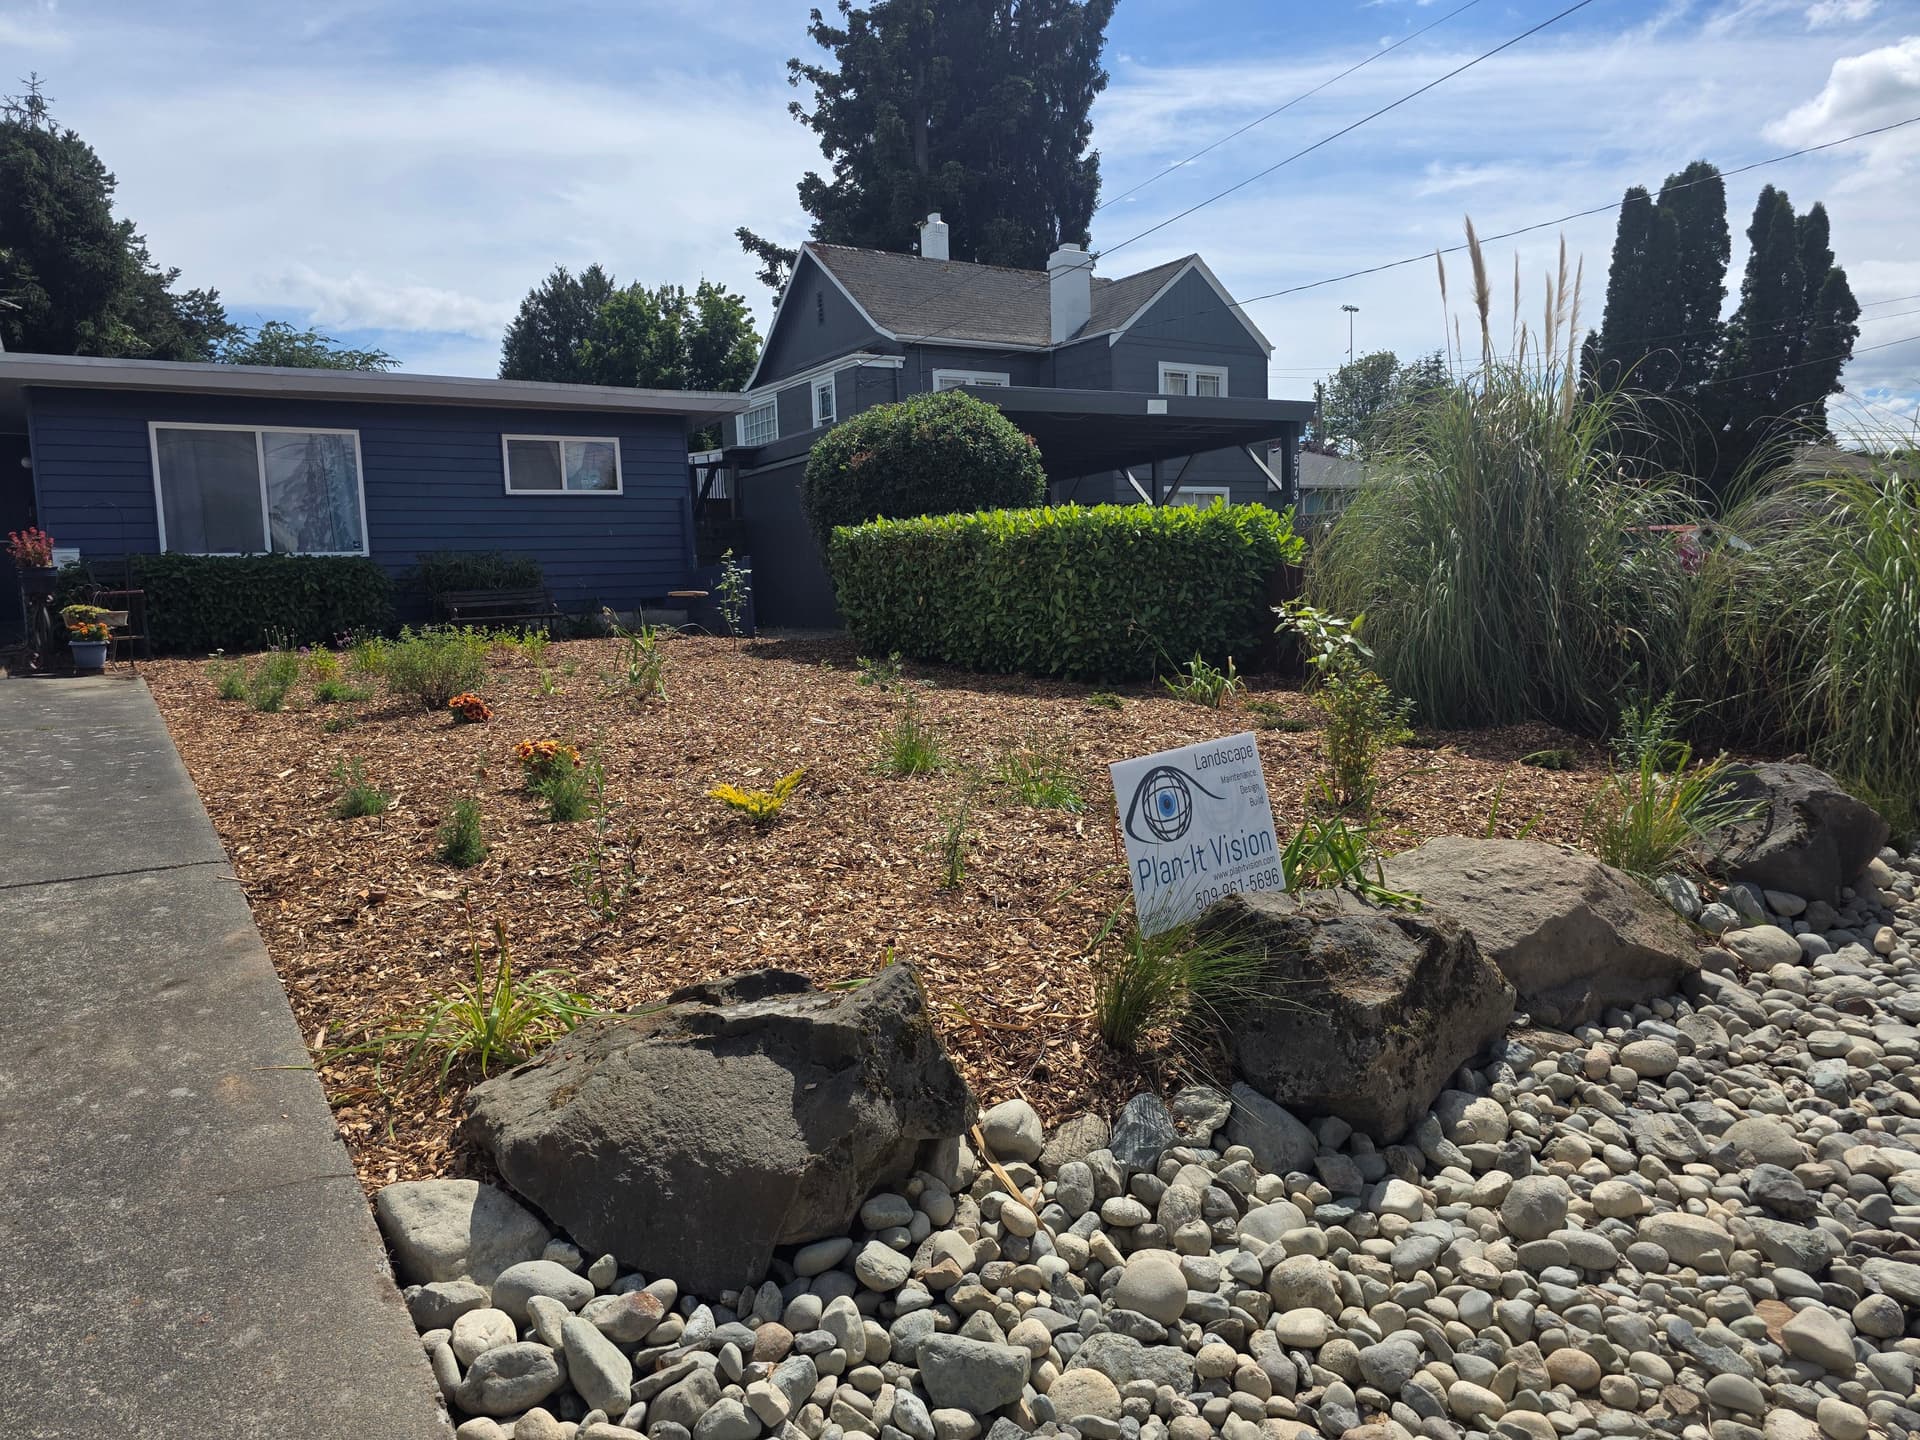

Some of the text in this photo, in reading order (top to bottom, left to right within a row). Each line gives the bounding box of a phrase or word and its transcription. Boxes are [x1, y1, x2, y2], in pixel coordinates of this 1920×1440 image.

[1194, 745, 1254, 770] Landscape
[1249, 795, 1264, 807] Build
[1137, 829, 1272, 891] Plan-It Vision
[1213, 855, 1276, 881] www.planitvision.com
[1195, 867, 1280, 910] 509-961-5696
